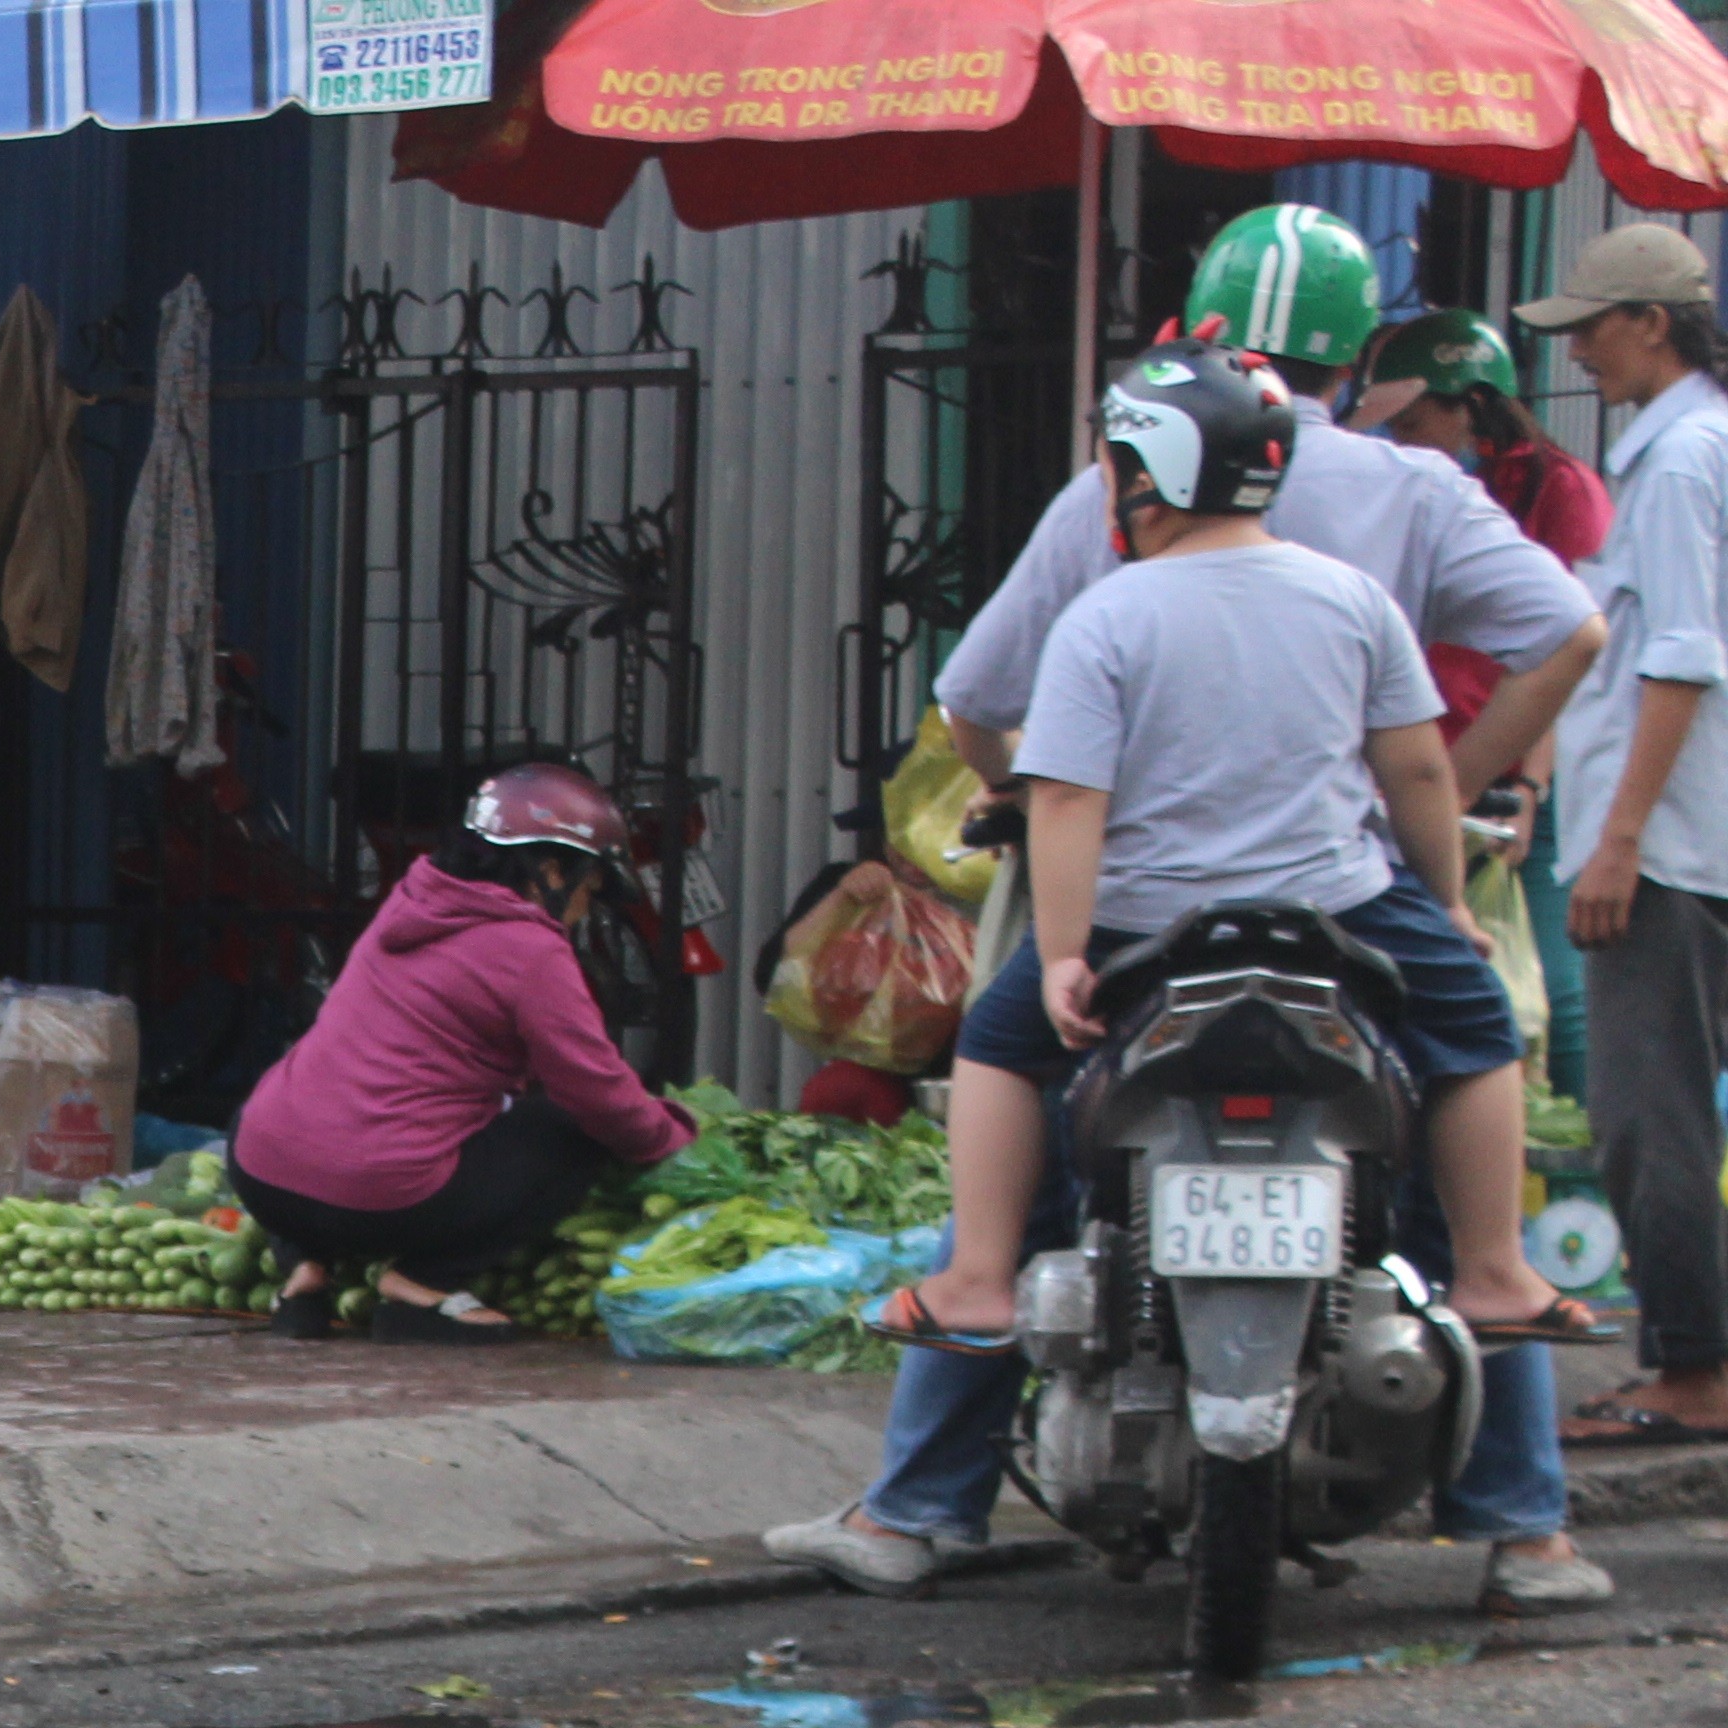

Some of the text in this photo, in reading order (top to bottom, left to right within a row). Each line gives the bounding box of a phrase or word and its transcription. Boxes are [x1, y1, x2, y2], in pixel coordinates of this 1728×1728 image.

[357, 29, 481, 68] 22116453
[318, 63, 482, 107] 093.3456 277
[599, 66, 725, 98] NÓNG
[738, 64, 867, 93] TRONG
[1238, 62, 1382, 94] TRONG
[722, 98, 788, 128] TRÀ
[797, 99, 855, 128] DR.
[867, 89, 1000, 117] THANH
[1322, 101, 1389, 128] DR.
[1399, 104, 1537, 138] THANH
[1185, 1175, 1303, 1219] 64-E1
[1167, 1224, 1326, 1267] 348.69
